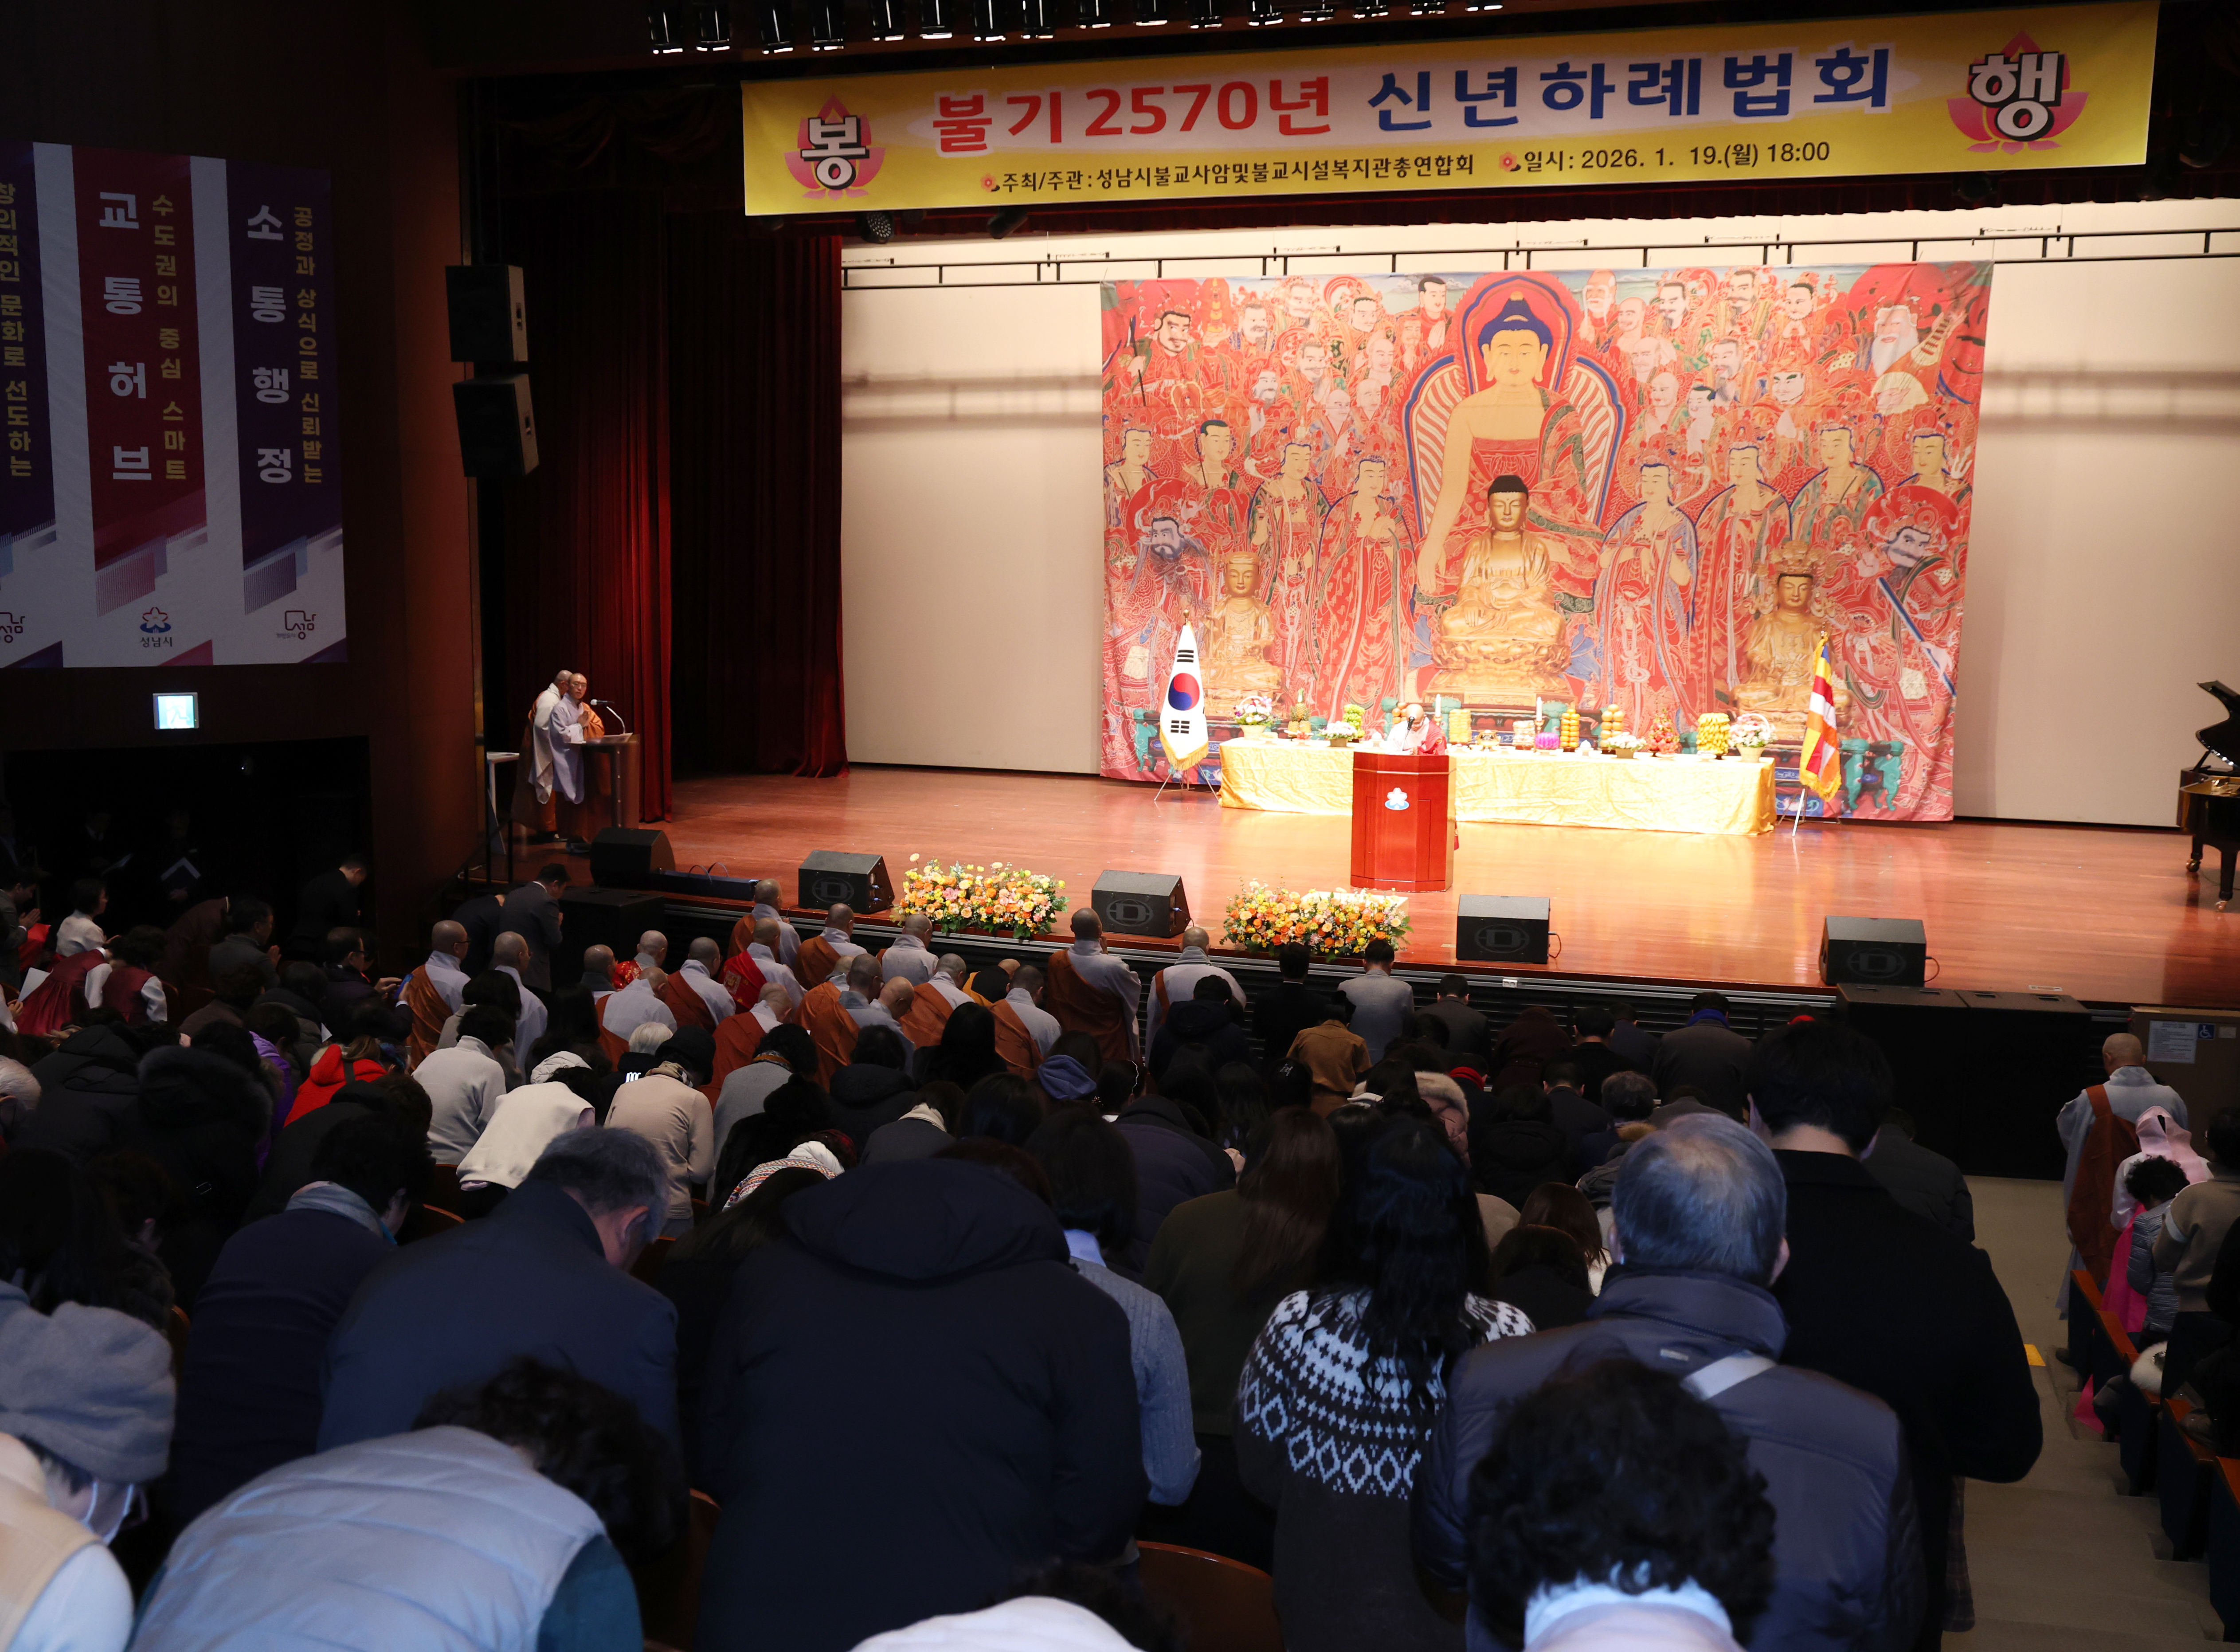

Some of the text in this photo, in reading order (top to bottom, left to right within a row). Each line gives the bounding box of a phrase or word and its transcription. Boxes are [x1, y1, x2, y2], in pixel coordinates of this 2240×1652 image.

[1368, 47, 1890, 131] 신년하례법회
[1969, 51, 2064, 141] 행
[801, 115, 869, 190] 봉
[1767, 141, 1830, 162] 18:00
[1, 294, 26, 367] 문화로
[99, 192, 152, 481] 교통허브
[152, 194, 186, 480] 수도권의 중심 스마트
[247, 204, 292, 484] 소통행정
[294, 206, 322, 483] 공정과 상식으로 신뢰받는
[5, 380, 31, 477] 선도하는
[140, 637, 173, 648] 성남시
